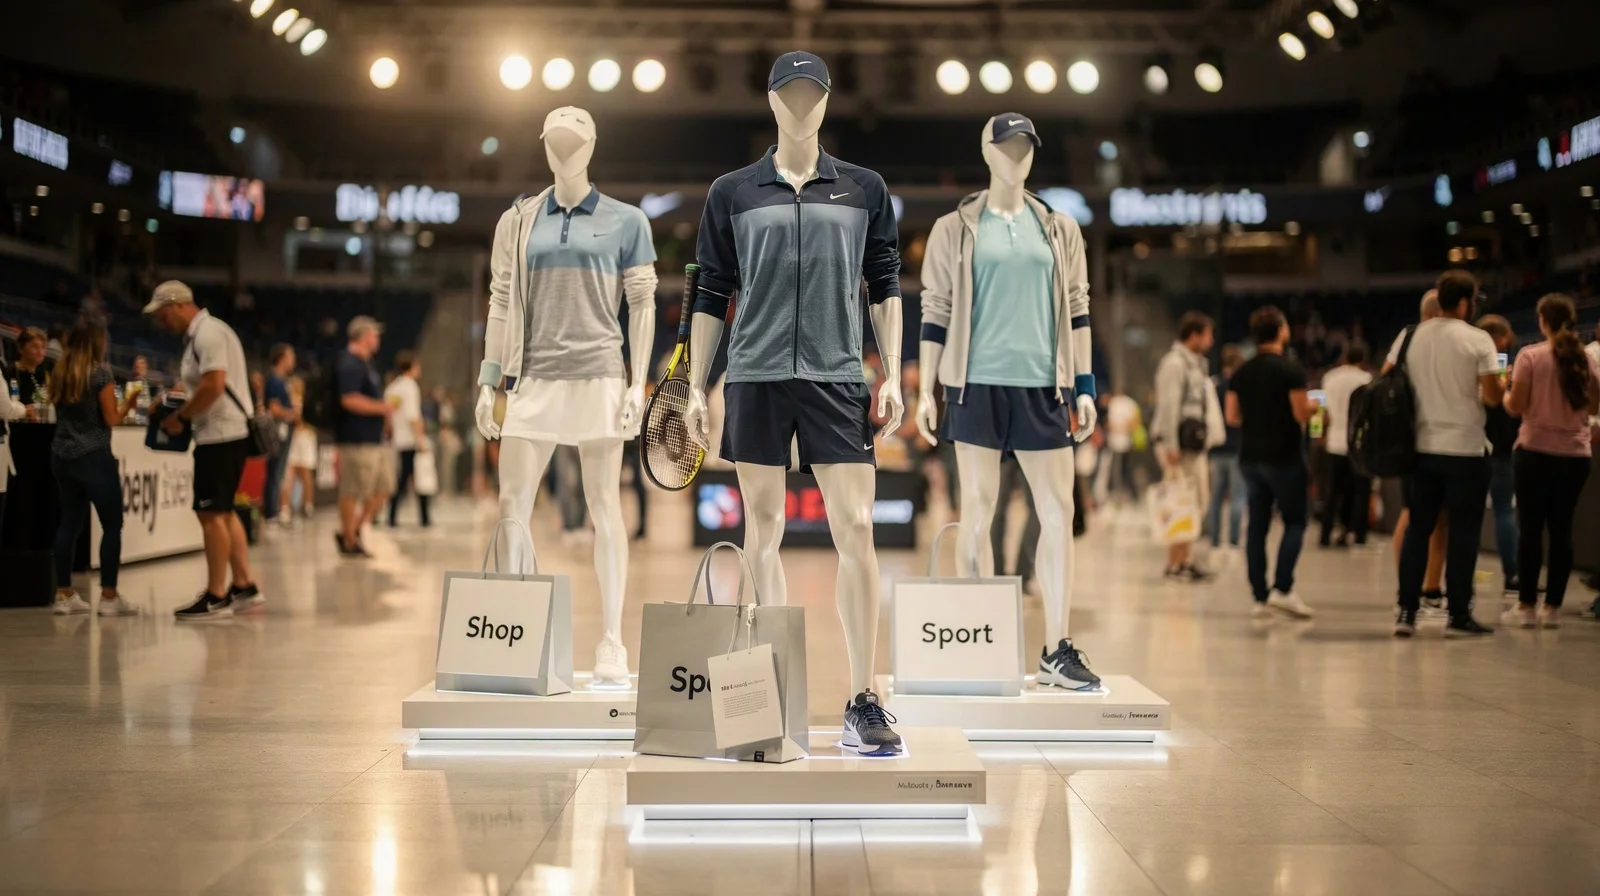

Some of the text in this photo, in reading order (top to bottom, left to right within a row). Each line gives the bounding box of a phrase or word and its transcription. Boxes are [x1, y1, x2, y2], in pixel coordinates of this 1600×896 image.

[465, 615, 524, 647] Shop
[922, 622, 993, 649] Sport
[669, 665, 711, 700] Sp
